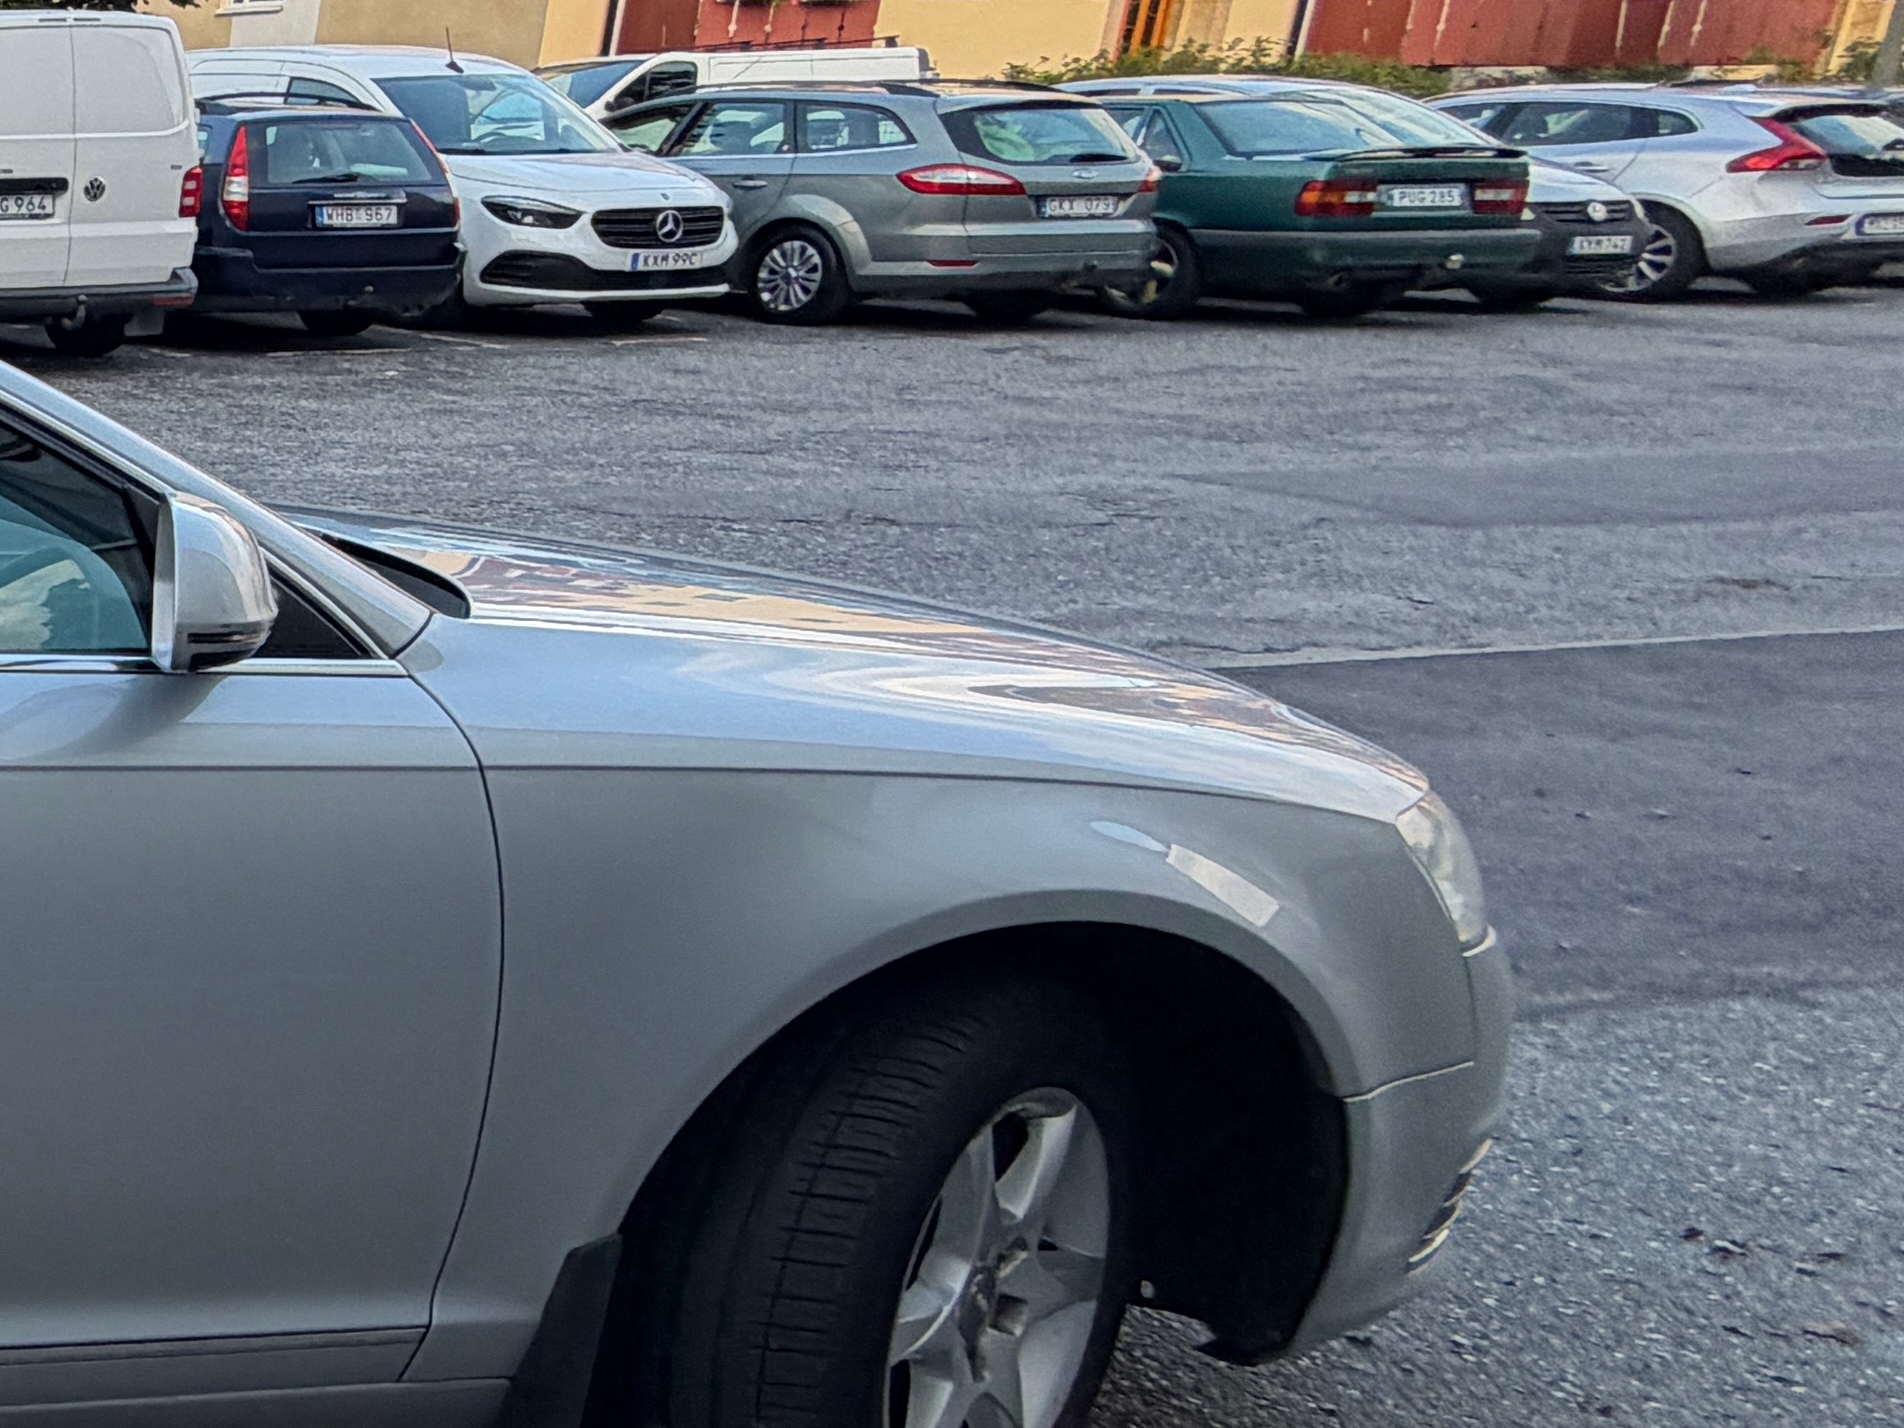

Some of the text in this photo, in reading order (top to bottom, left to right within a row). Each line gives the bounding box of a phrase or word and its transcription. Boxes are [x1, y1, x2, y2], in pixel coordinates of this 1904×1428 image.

[14, 196, 48, 213] 964
[325, 207, 393, 223] WHB 967
